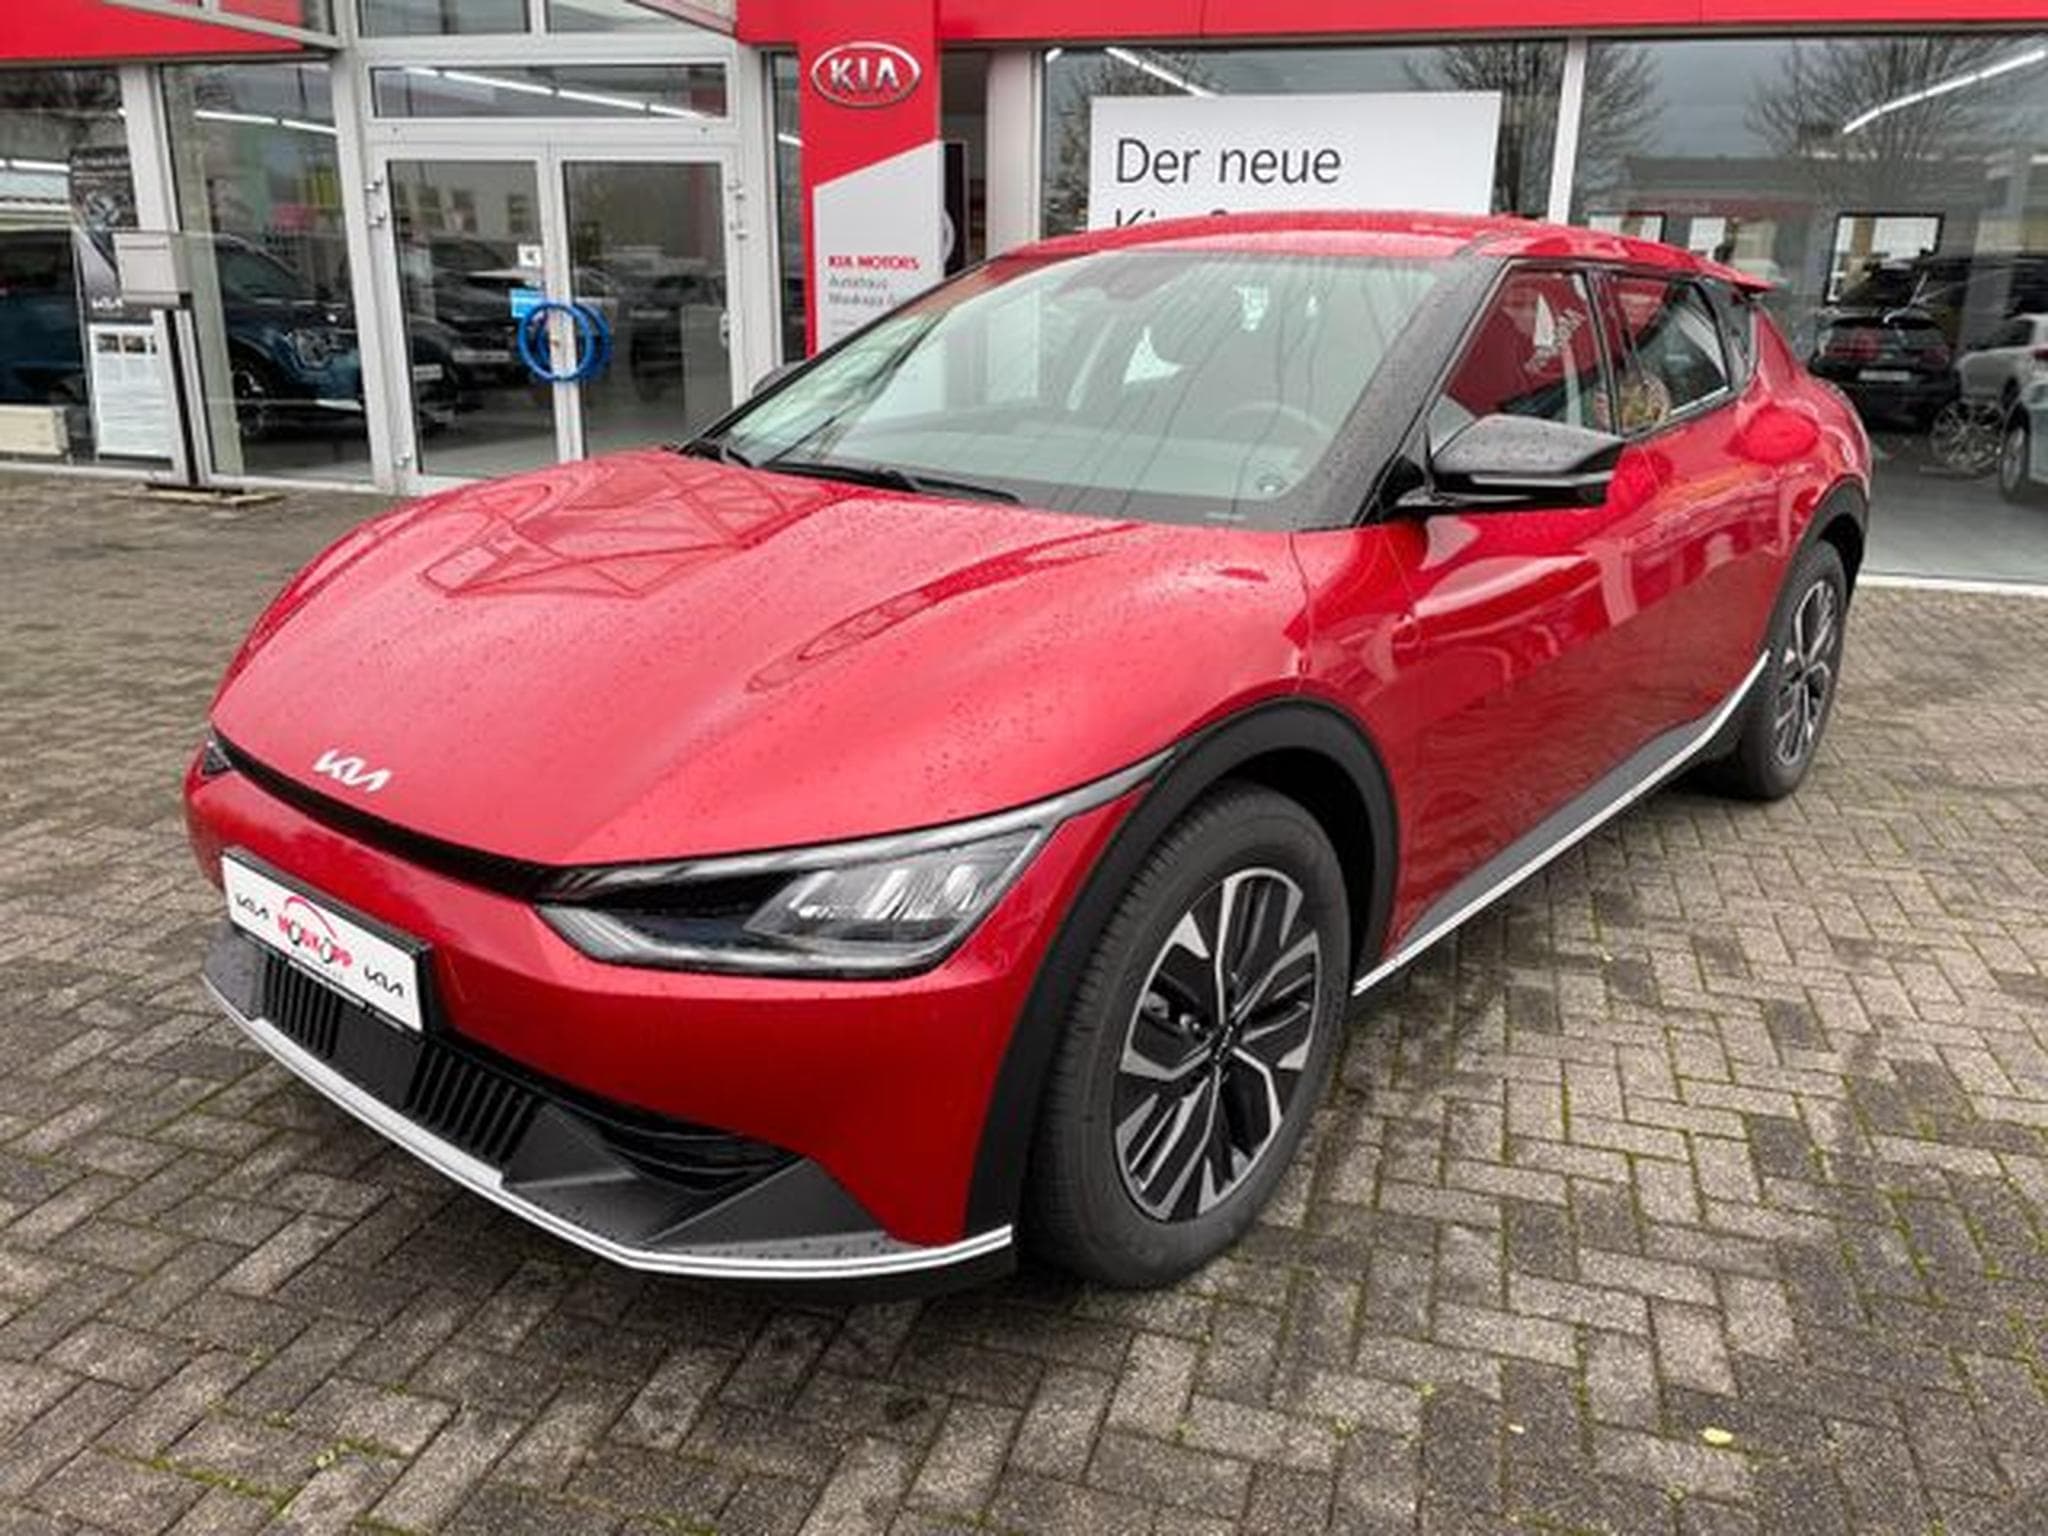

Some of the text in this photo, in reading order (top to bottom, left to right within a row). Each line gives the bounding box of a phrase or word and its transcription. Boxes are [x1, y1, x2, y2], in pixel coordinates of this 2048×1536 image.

[829, 57, 900, 91] KIA
[1116, 137, 1342, 184] Der neue
[828, 255, 919, 270] KIA MOTORS
[312, 748, 392, 792] KIA
[364, 964, 404, 999] KIA
